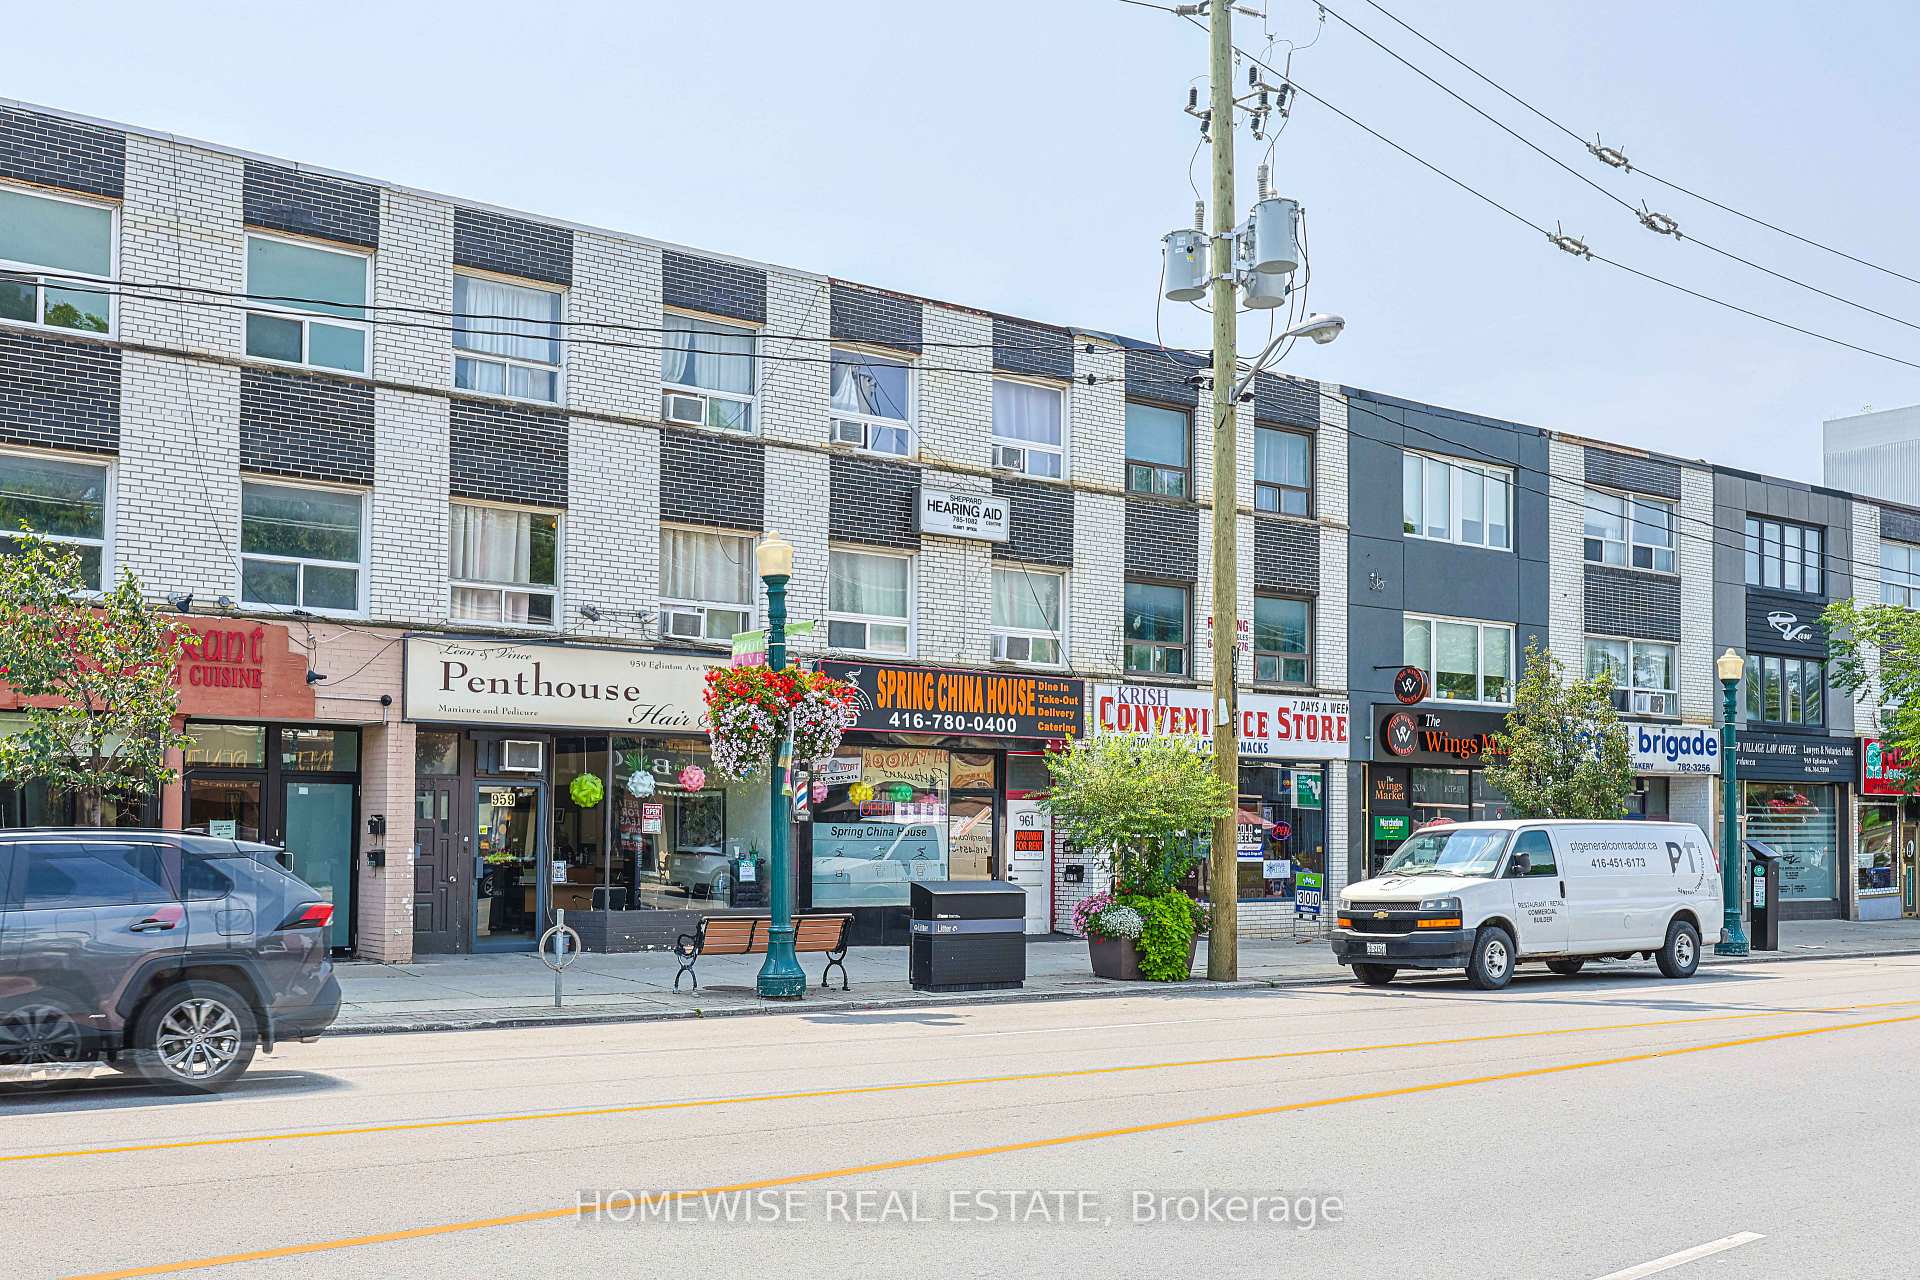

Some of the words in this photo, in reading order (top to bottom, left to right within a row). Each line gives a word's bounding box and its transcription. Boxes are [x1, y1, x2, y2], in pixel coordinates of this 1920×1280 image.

[950, 495, 982, 505] SHEPPARD
[927, 499, 980, 518] HEARING
[983, 508, 1002, 520] AID
[496, 647, 532, 660] Vince
[649, 661, 683, 670] Eglinton
[189, 665, 262, 688] CUISINE
[439, 660, 640, 702] Penthouse
[877, 669, 935, 711] SPRING
[938, 673, 985, 714] CHINA
[987, 677, 1035, 716] HOUSE
[1038, 681, 1059, 691] Dine
[1060, 682, 1070, 692] In
[1037, 694, 1079, 705] Take-Out
[1117, 687, 1168, 706] KRISH
[439, 704, 481, 714] Manicure
[483, 707, 498, 715] and
[502, 707, 538, 717] Pedicure
[1038, 707, 1075, 719] Delivery
[1293, 701, 1298, 709] 7
[1300, 701, 1319, 712] DAYS
[1321, 703, 1327, 712] A
[628, 704, 690, 726] Hair
[1099, 696, 1268, 740] CONVENICE
[1277, 707, 1349, 743] STORE
[1425, 713, 1441, 727] The
[889, 711, 1018, 733] 416-780-0400
[1037, 721, 1077, 734] Catering
[1425, 730, 1478, 759] Wings
[1638, 726, 1718, 762] brigade
[1743, 742, 1765, 753] VILLAGE
[1766, 744, 1777, 753] LAW
[1778, 744, 1797, 755] OFFICE
[1842, 747, 1854, 756] Public
[1678, 763, 1711, 772] 782-3256
[1377, 780, 1403, 792] Wings
[492, 794, 514, 805] 959
[1375, 790, 1405, 800] Market
[1019, 814, 1034, 827] 961
[831, 826, 864, 838] Spring
[866, 826, 894, 837] China
[1015, 831, 1043, 841] APARTMENT
[1015, 841, 1028, 851] FOR
[1029, 841, 1043, 851] RENT
[1570, 840, 1658, 853] ptgeneralcontractor.ca
[1591, 857, 1646, 868] 416-451-6173
[937, 924, 951, 933] Litter
